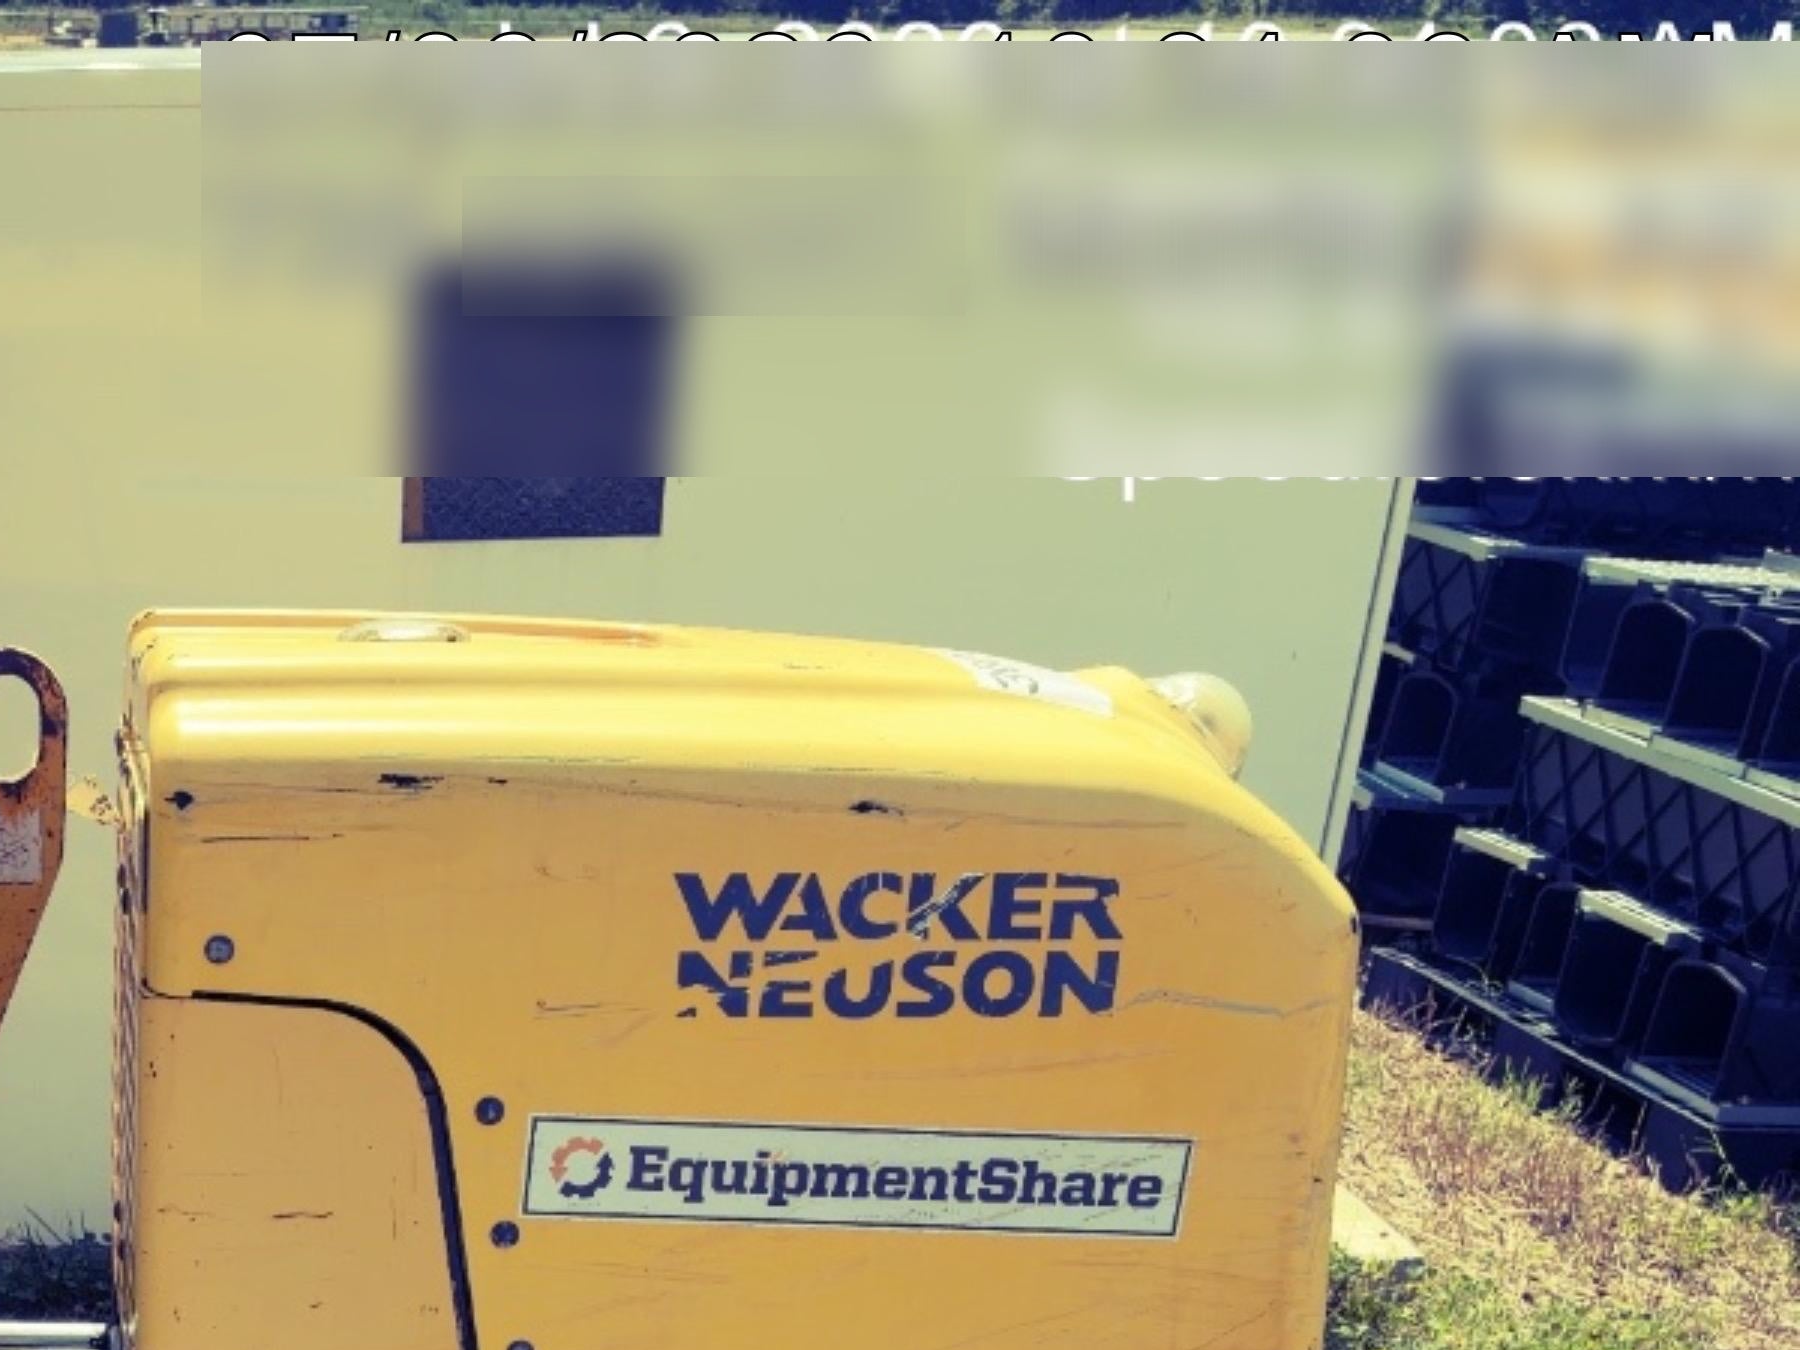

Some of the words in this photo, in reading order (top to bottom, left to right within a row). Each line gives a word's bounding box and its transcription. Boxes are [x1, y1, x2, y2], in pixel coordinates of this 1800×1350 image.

[674, 872, 1124, 941] WACKER
[676, 950, 1121, 1018] NEUSON
[626, 1145, 1164, 1208] EquipmentShare
